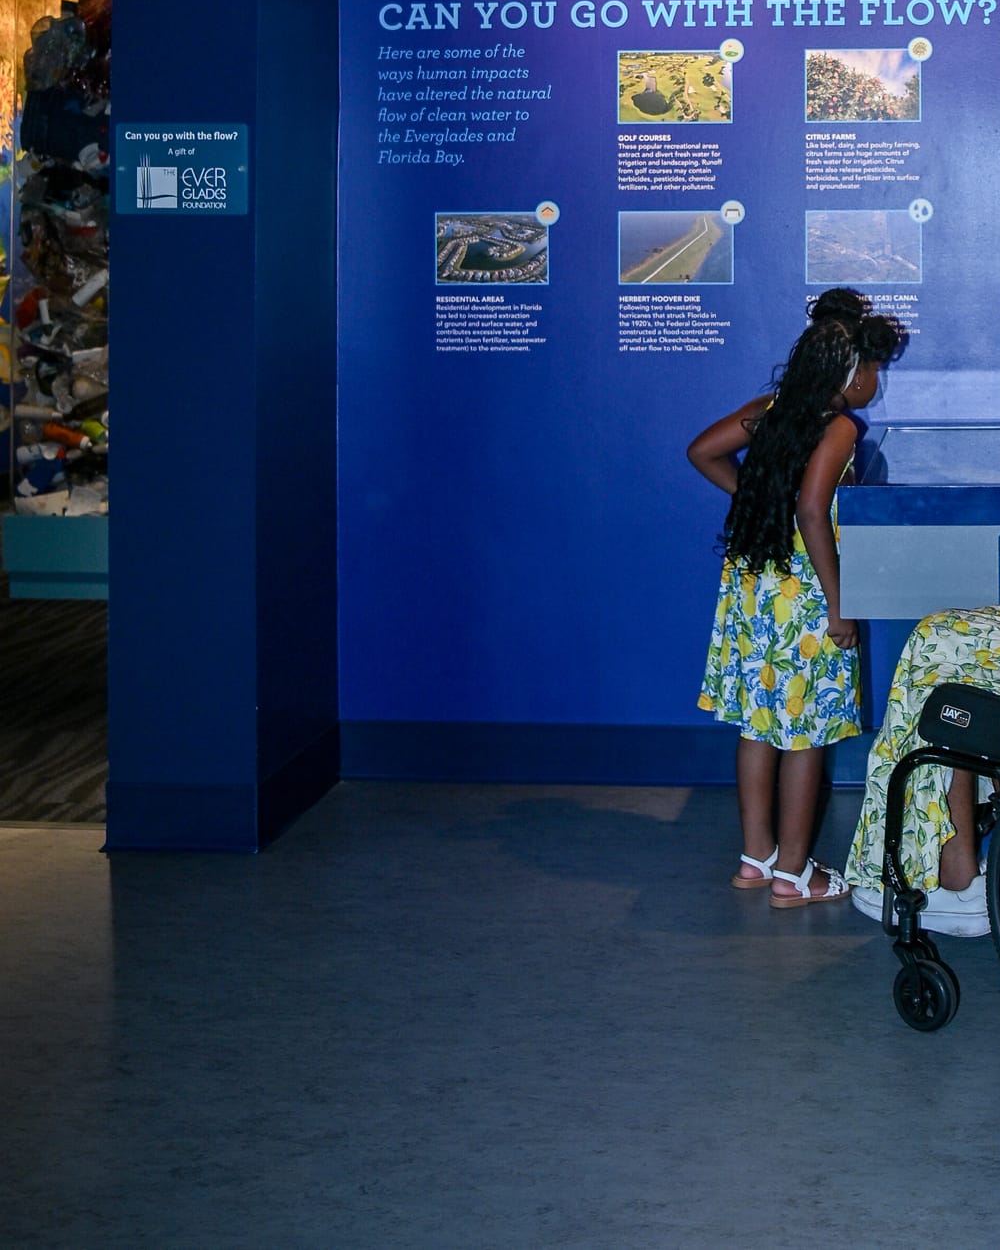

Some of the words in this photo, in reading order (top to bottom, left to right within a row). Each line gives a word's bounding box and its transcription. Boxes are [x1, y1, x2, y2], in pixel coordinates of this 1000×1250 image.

[379, 2, 461, 30] CAN
[474, 1, 557, 29] YOU
[571, 0, 628, 28] GO
[642, 0, 753, 27] WITH
[378, 47, 413, 59] Here
[417, 50, 440, 59] are
[444, 49, 481, 59] some
[485, 46, 501, 58] of
[502, 46, 525, 58] the
[379, 70, 413, 83] ways
[417, 67, 467, 79] human
[471, 66, 529, 82] impacts
[378, 88, 412, 100] have
[416, 87, 467, 100] altered
[471, 87, 493, 100] the
[497, 87, 551, 99] natural
[378, 109, 406, 121] flow
[410, 109, 427, 121] of
[428, 108, 466, 121] clean
[471, 108, 512, 121] water
[515, 108, 529, 120] to
[125, 132, 142, 140] Can
[175, 132, 195, 140] with
[197, 132, 212, 140] the
[214, 132, 238, 140] flow?
[379, 130, 400, 142] the
[404, 129, 483, 145] Everglades
[487, 129, 516, 141] and
[378, 151, 430, 163] Florida
[435, 150, 464, 166] Bay.
[182, 168, 226, 187] EVER
[182, 189, 226, 199] GLADES
[943, 707, 962, 719] JAY
